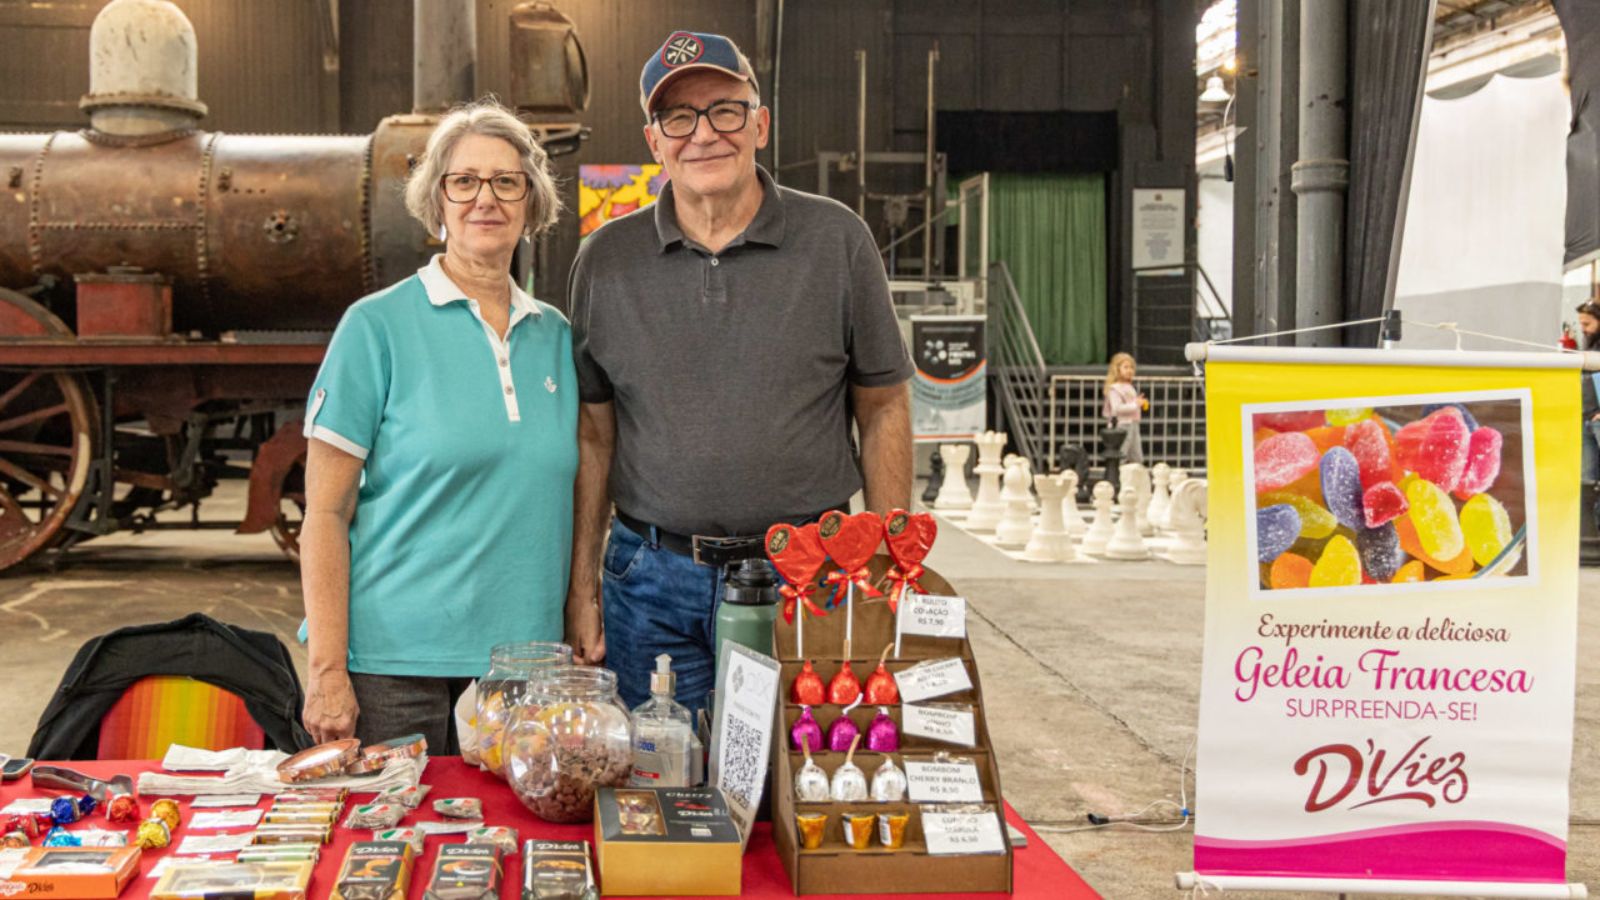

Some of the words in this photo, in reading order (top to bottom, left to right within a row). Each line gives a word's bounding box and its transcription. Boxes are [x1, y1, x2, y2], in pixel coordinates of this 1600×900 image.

[1257, 613, 1394, 646] Experimente
[1396, 626, 1412, 641] a
[1415, 617, 1511, 643] deliciosa
[1234, 646, 1352, 702] Geleia
[1357, 647, 1535, 694] Francesa
[1285, 698, 1478, 721] SURPREENDA-SE!
[1293, 735, 1469, 813] D'Viez
